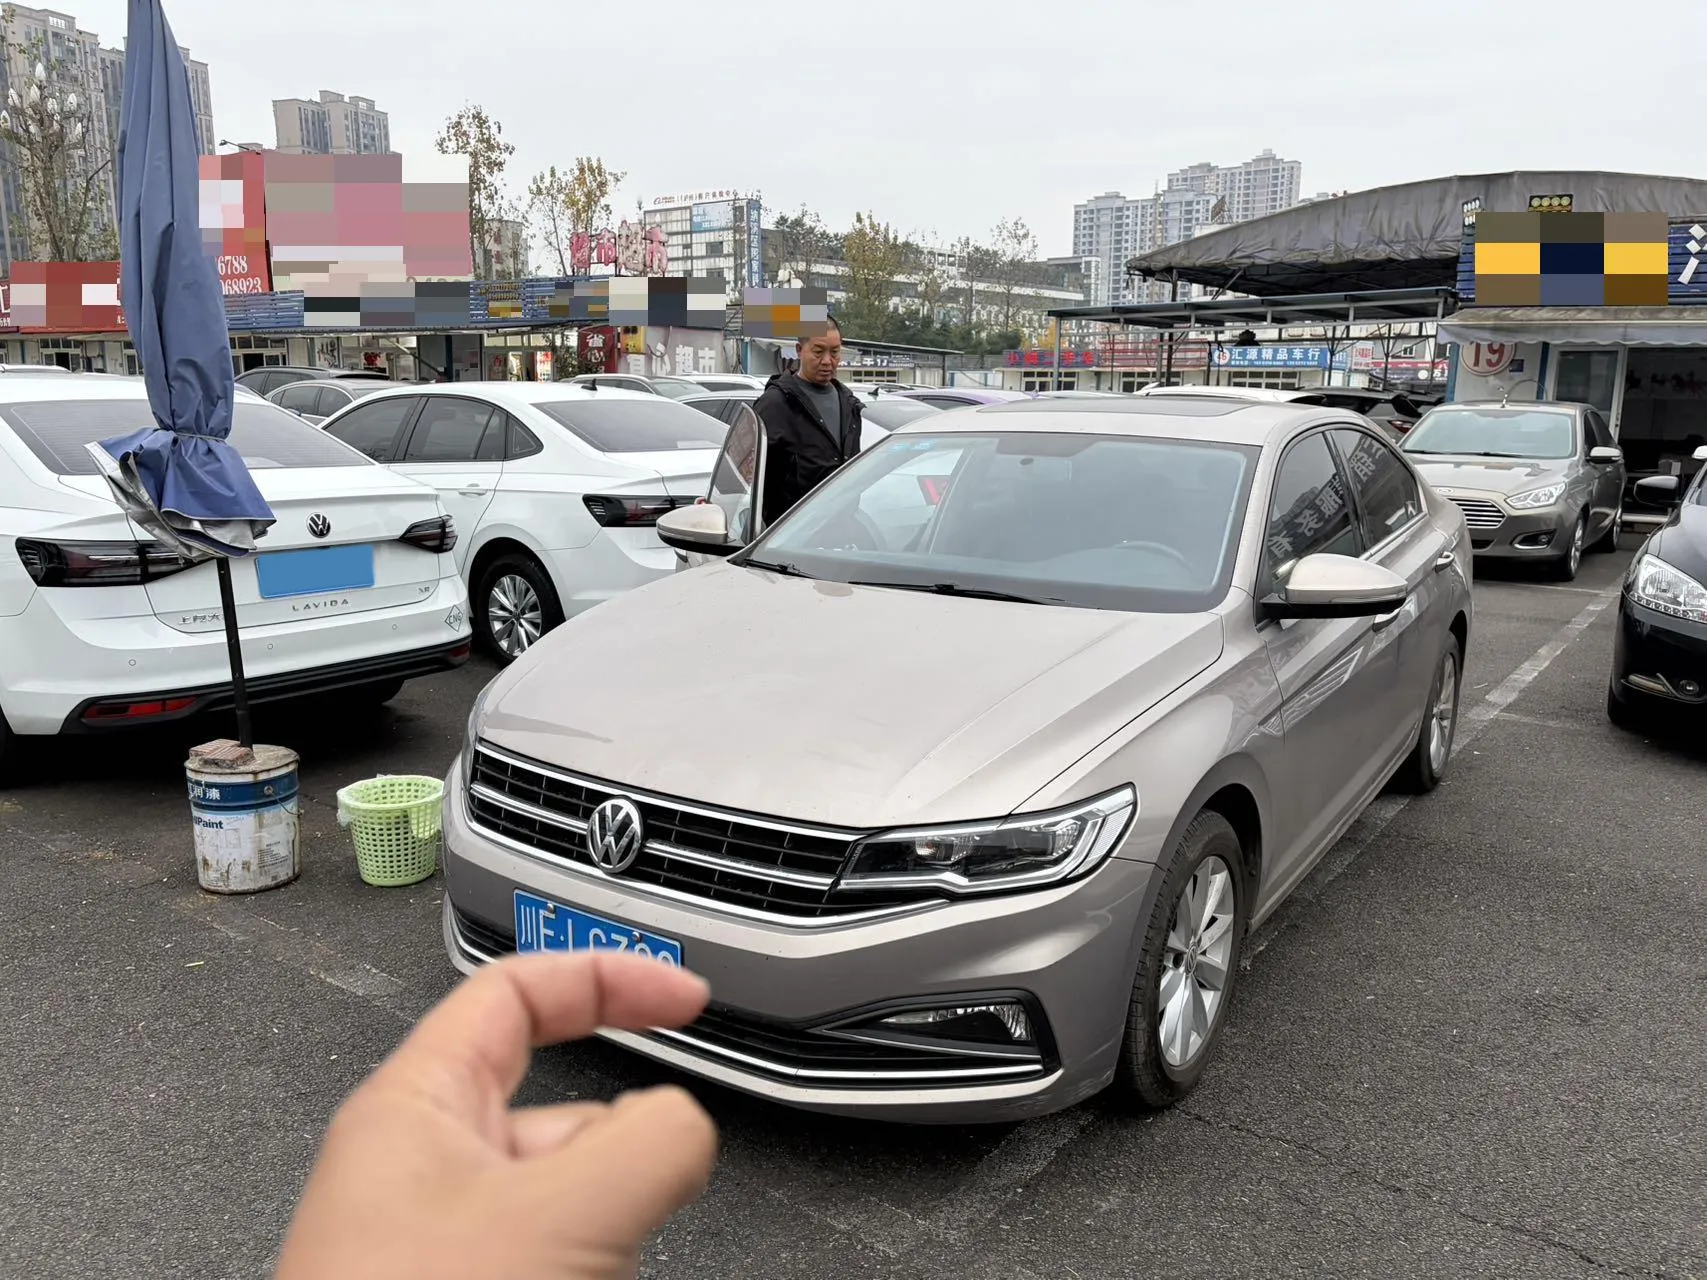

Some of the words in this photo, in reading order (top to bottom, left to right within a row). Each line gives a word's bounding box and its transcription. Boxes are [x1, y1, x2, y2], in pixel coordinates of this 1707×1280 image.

[1231, 348, 1321, 360] 汇源精品车行
[1473, 342, 1506, 367] 19
